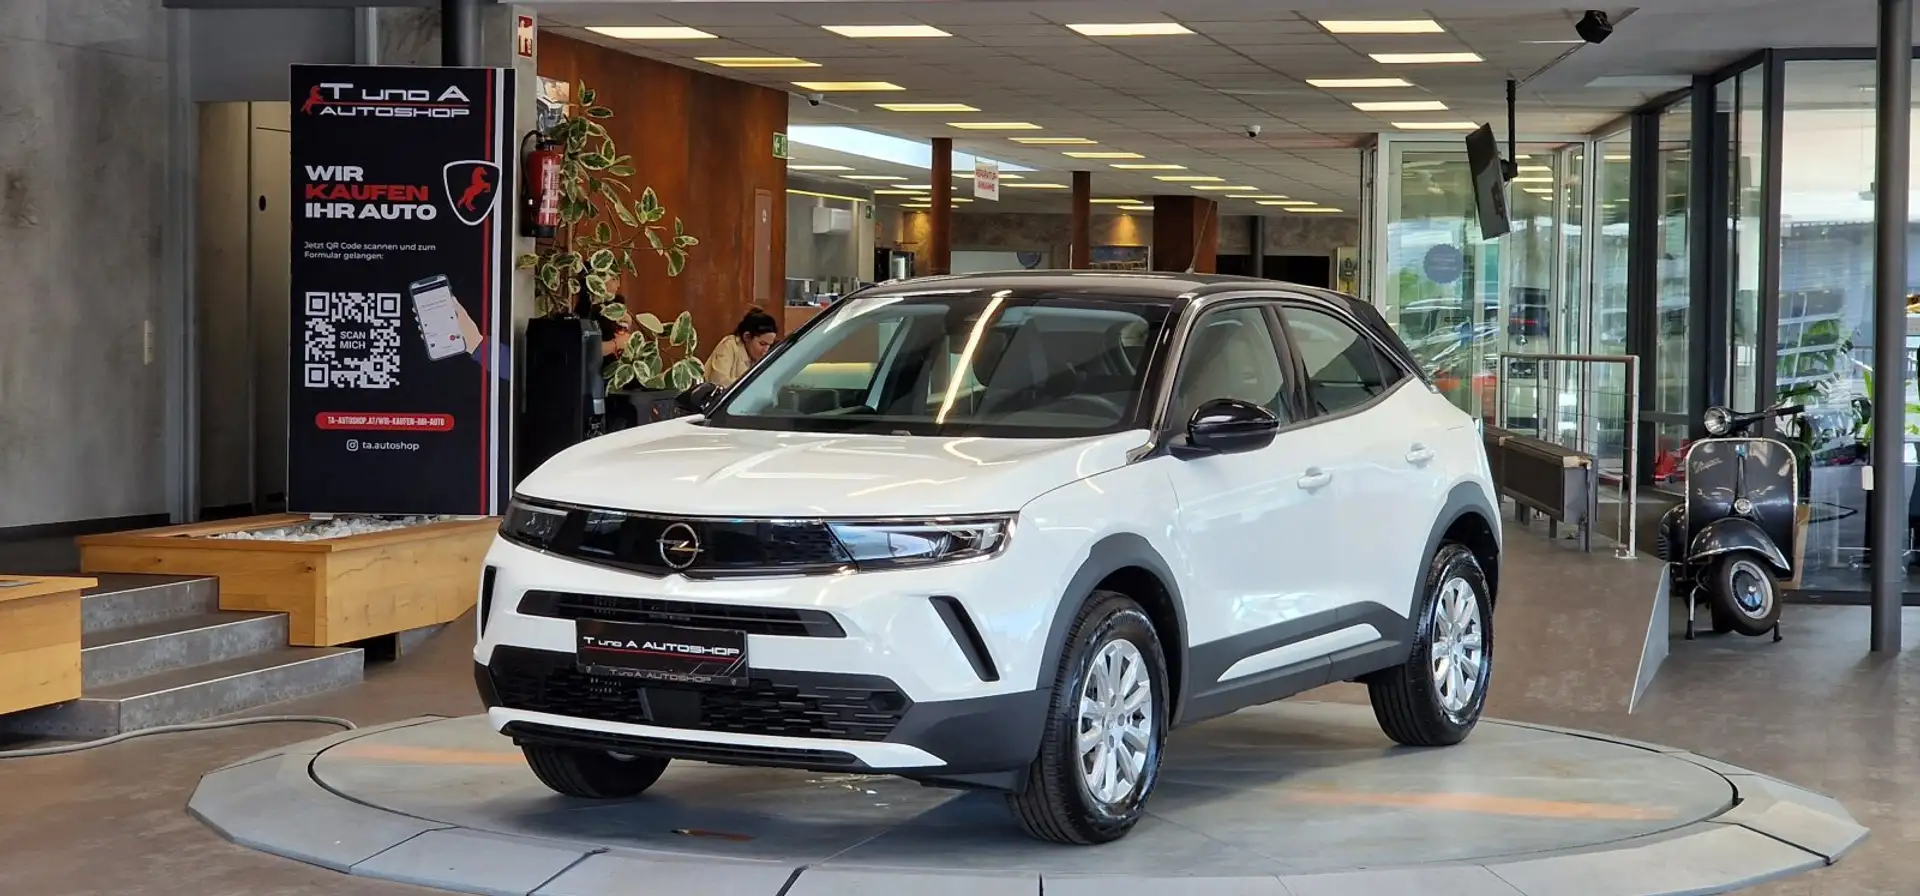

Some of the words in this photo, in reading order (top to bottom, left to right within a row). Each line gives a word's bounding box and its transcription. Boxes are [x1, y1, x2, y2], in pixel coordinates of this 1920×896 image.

[320, 82, 354, 100] T
[436, 85, 470, 102] A
[319, 106, 470, 118] AUTOSHOP
[304, 165, 364, 182] WIR
[305, 184, 429, 201] KAUFEN
[305, 202, 355, 219] IHR
[358, 203, 437, 221] AUTO
[304, 241, 324, 250] Jetzt
[325, 241, 339, 251] QR
[340, 242, 362, 250] Code
[363, 242, 398, 251] scannen
[400, 243, 416, 251] und
[304, 250, 341, 259] Formular
[343, 251, 384, 261] gelangen:
[340, 330, 366, 340] SCAN
[340, 340, 366, 350] MICH
[362, 441, 420, 452] ta.autoshop
[583, 636, 595, 644] T
[626, 640, 638, 649] A
[642, 641, 740, 656] AUTOSHOP
[647, 672, 711, 683] AUTOSHOP
